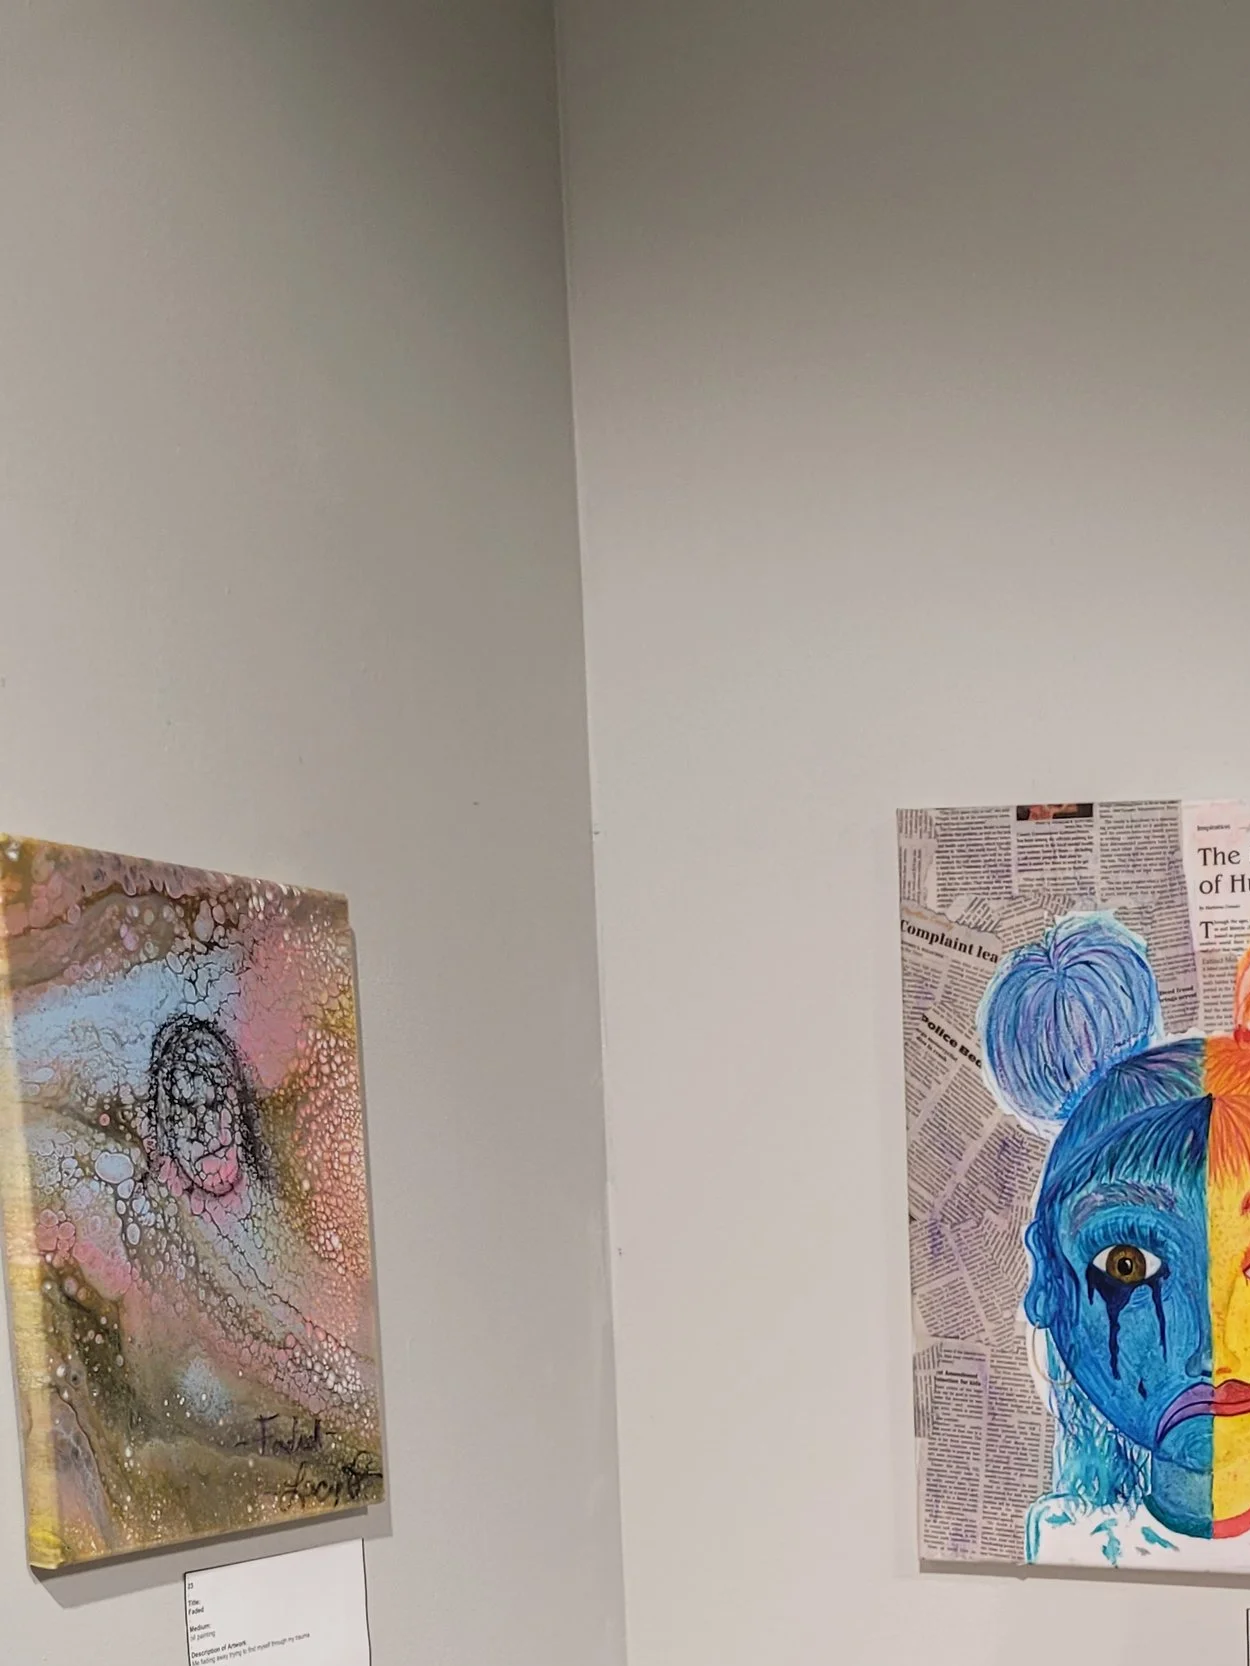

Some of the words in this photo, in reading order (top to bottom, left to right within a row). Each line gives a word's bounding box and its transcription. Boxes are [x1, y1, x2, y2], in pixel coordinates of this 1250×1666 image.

[1198, 846, 1241, 867] The
[1199, 874, 1223, 895] of
[900, 919, 974, 956] Complaint
[921, 1013, 958, 1049] Police
